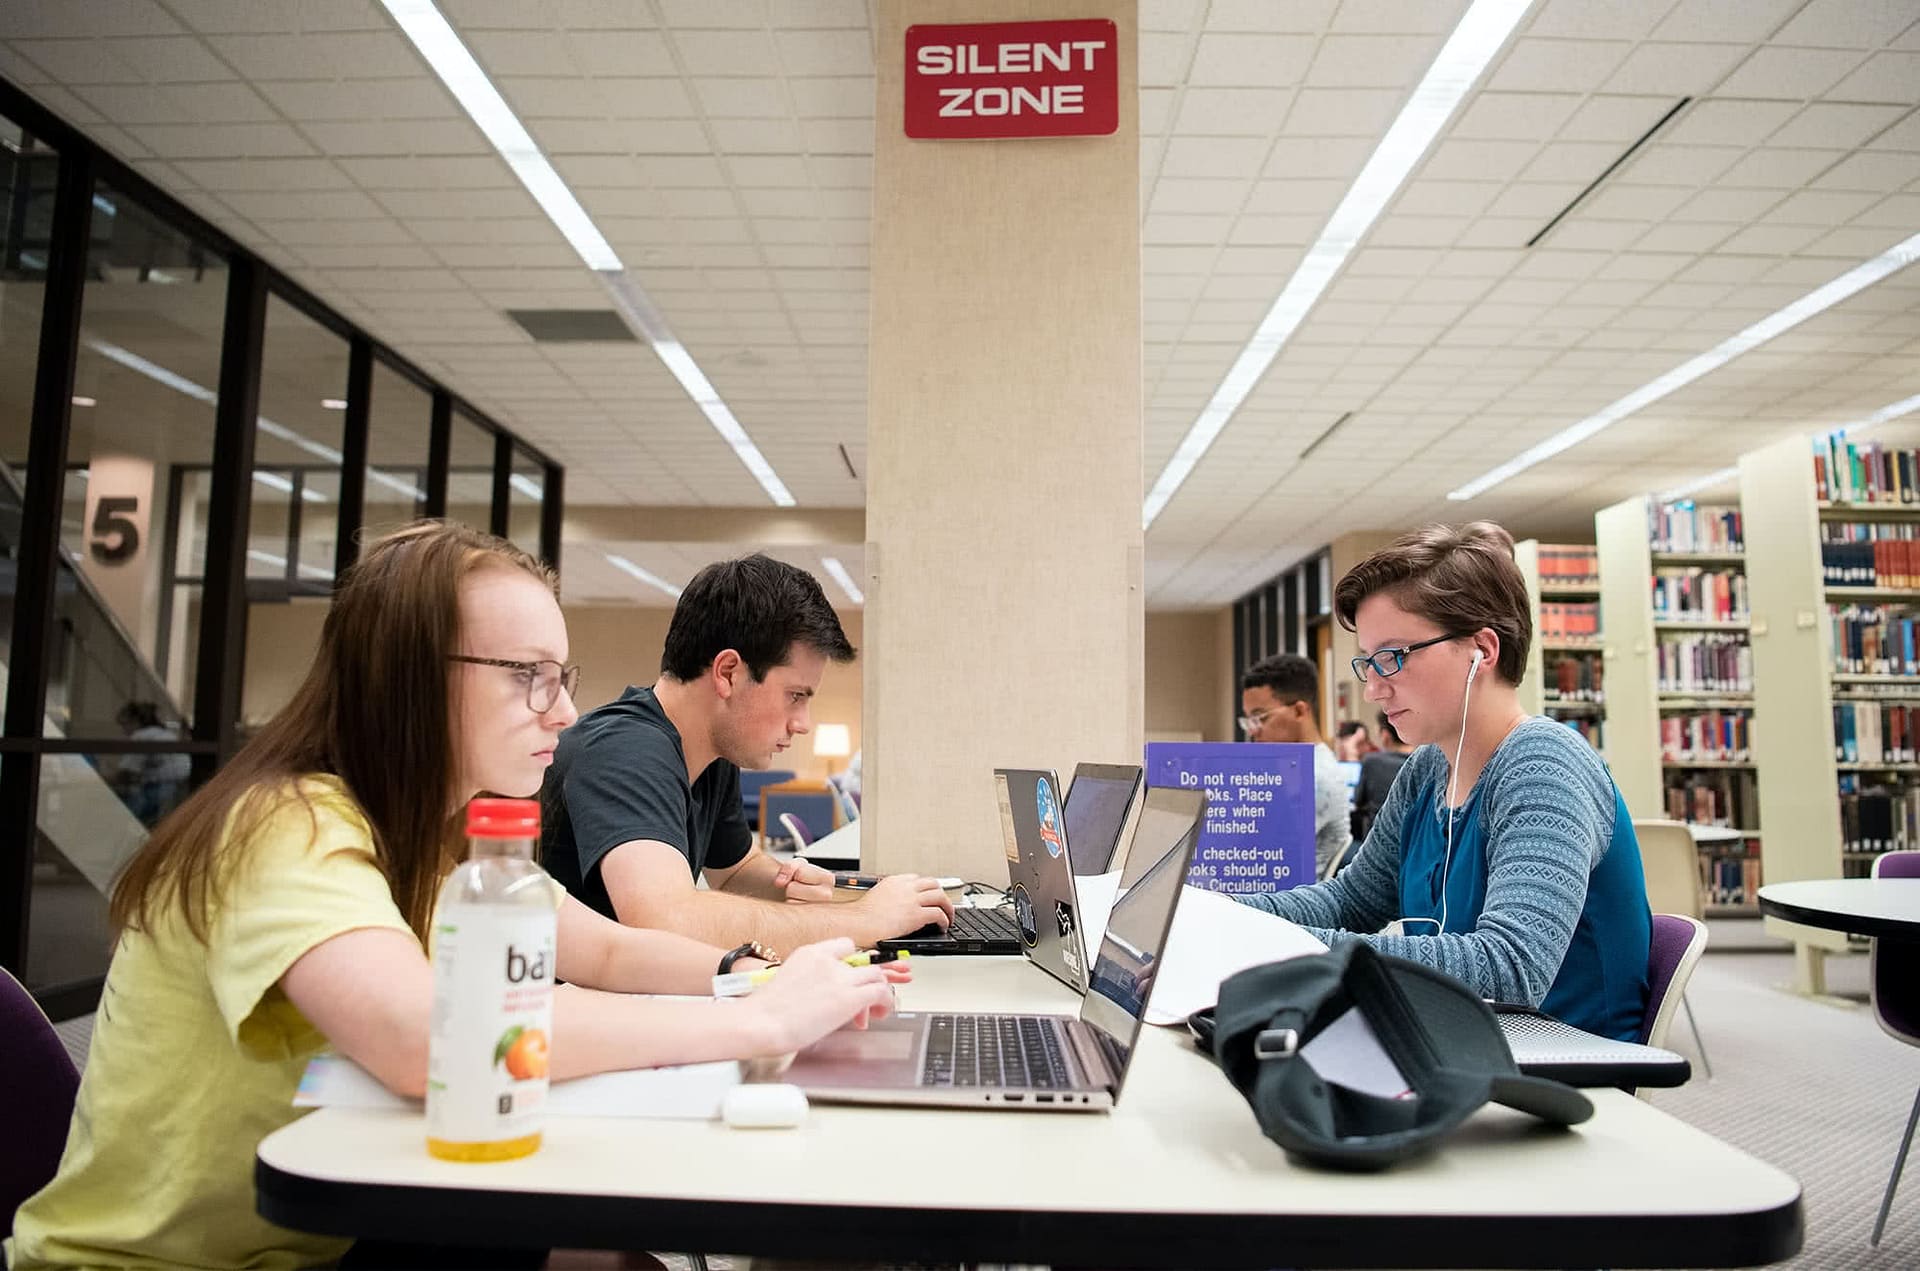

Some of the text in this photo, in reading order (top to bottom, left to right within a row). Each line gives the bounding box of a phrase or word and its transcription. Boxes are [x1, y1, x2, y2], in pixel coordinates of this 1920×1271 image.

[916, 41, 1106, 75] SILENT
[938, 85, 1085, 117] ZONE
[90, 496, 139, 568] 5
[1180, 772, 1282, 786] Do not reshelve
[1206, 787, 1273, 802] oks. Place
[1205, 804, 1265, 818] ere when
[1206, 820, 1259, 834] finished.
[1203, 846, 1283, 860] checked-out
[1187, 862, 1290, 879] ooks should go
[1209, 878, 1276, 892] Circulation
[506, 944, 553, 984] ba
